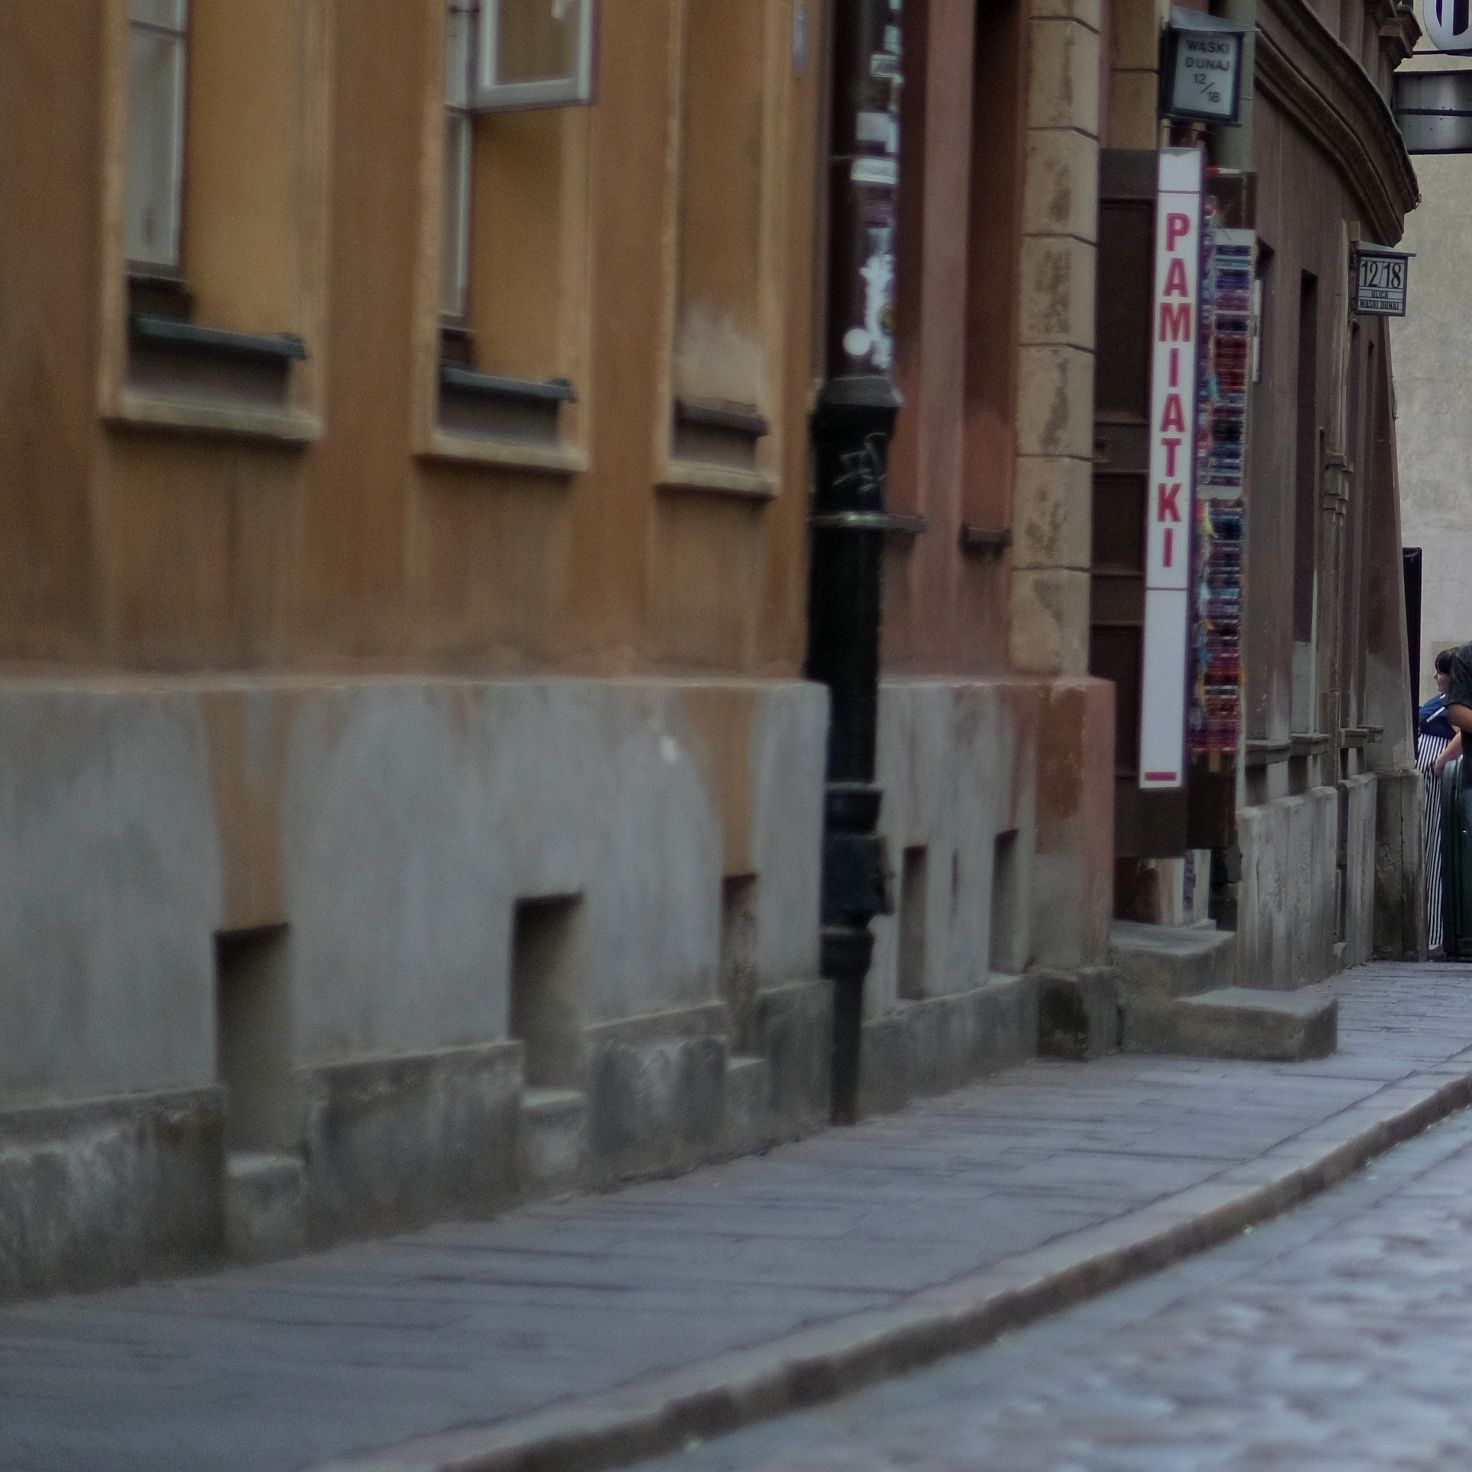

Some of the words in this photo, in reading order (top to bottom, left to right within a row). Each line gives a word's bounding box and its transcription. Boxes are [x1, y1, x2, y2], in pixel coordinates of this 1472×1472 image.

[1186, 57, 1231, 72] DUNAJ
[1361, 260, 1402, 289] 12/18
[1157, 212, 1192, 568] PAMIATKI
